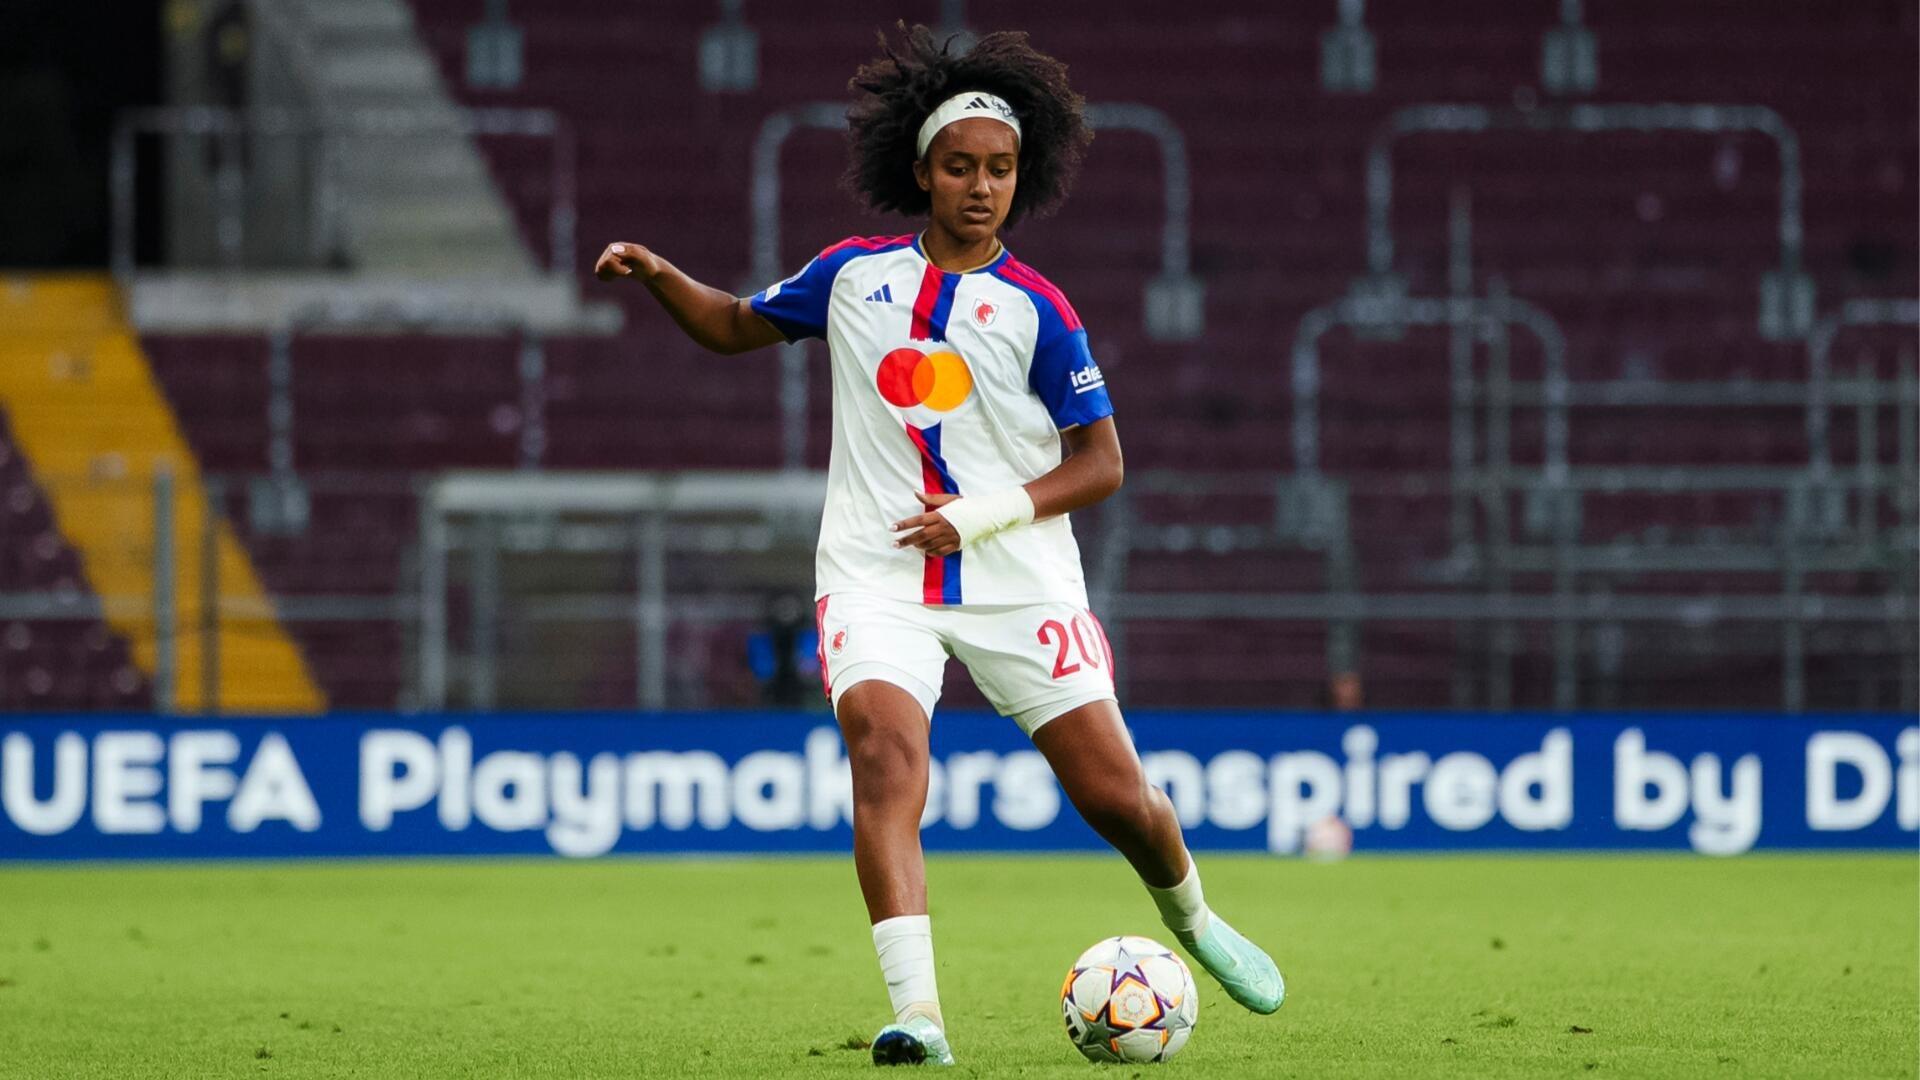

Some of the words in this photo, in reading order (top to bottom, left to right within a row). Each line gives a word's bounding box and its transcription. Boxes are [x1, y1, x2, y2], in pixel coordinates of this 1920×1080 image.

[1037, 613, 1100, 680] 20
[3, 731, 322, 835] UEFA
[1131, 724, 1574, 856] nspired
[1613, 727, 1762, 855] by
